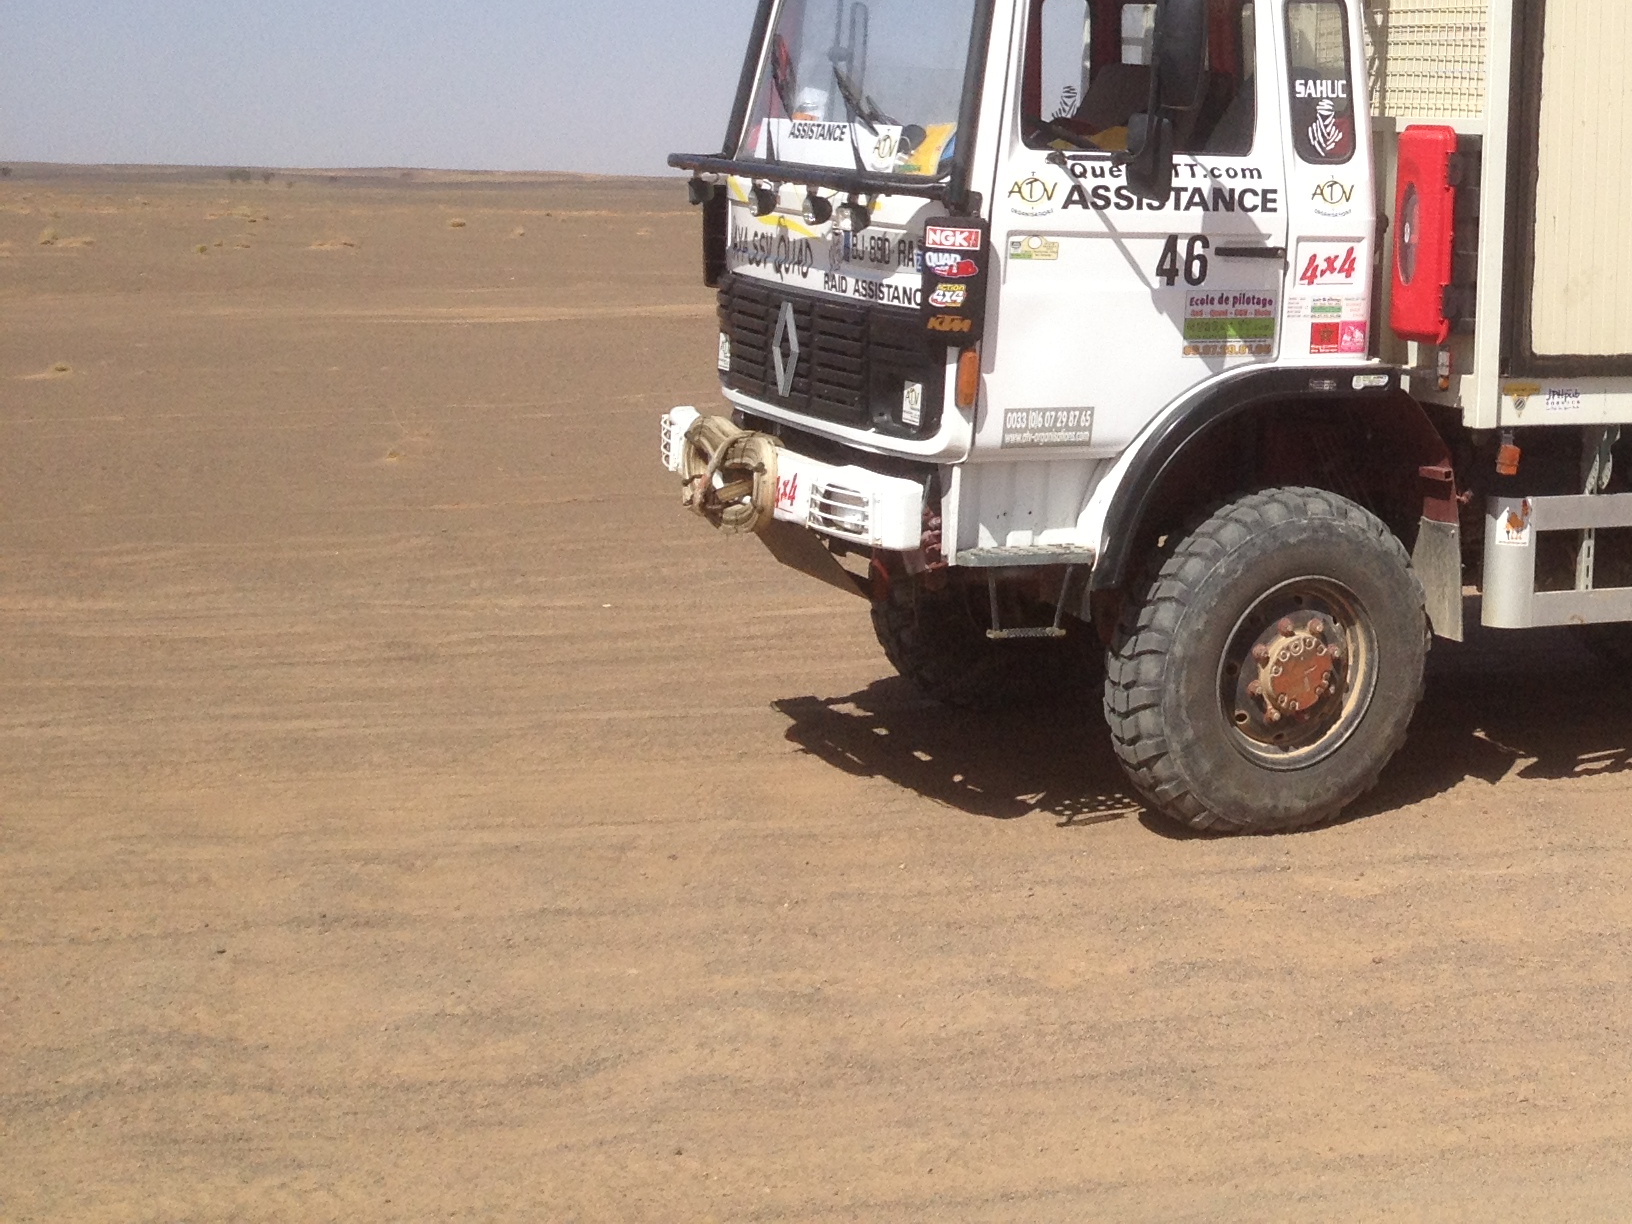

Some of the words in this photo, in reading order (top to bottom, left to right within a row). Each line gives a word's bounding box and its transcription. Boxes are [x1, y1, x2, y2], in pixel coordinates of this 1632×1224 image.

[1295, 79, 1347, 97] SAHUC
[789, 122, 847, 142] ASSISTANCE
[1070, 162, 1263, 180] QueTT.com
[1007, 177, 1058, 202] ATV
[1311, 180, 1354, 204] ATV
[928, 229, 970, 247] NGK
[774, 235, 813, 282] QUAD
[925, 251, 961, 267] QUAD
[1156, 234, 1210, 287] 46
[1299, 245, 1357, 286] 4x4
[824, 273, 848, 294] RAID
[852, 278, 922, 307] ASSISTANC
[1189, 294, 1215, 307] Ecole
[1218, 292, 1230, 305] de
[1006, 412, 1027, 429] 0033
[1044, 411, 1056, 427] 07
[1056, 410, 1068, 427] 29
[1080, 410, 1092, 427] 65
